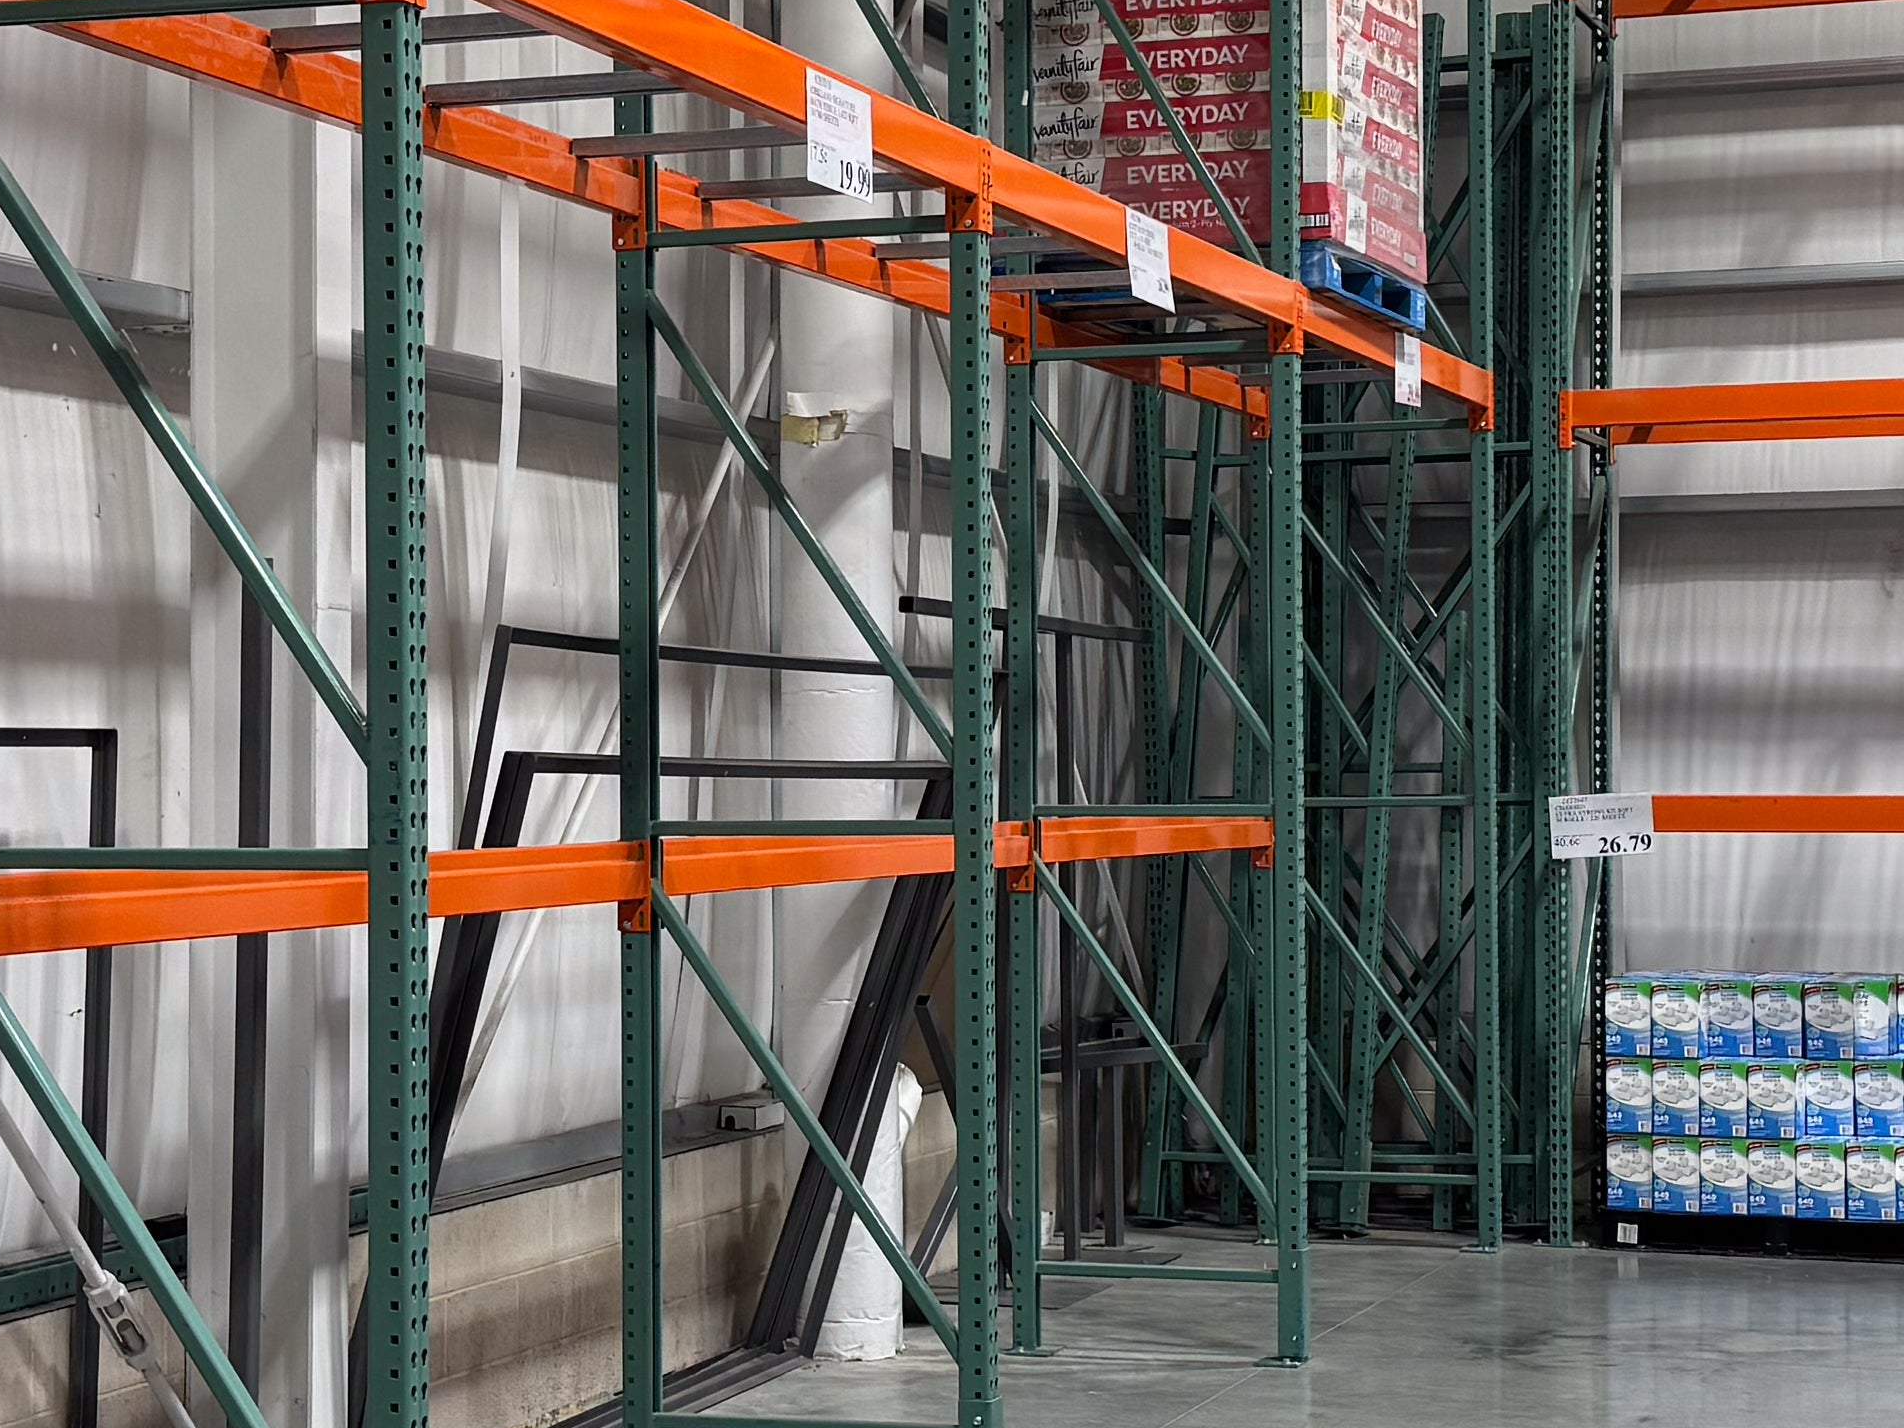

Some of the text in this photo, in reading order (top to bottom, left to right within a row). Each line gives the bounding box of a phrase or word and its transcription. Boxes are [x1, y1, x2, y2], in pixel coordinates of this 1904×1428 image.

[1126, 103, 1249, 130] EVERYDAY
[840, 160, 871, 197] 19.99
[1598, 834, 1651, 853] 26.79
